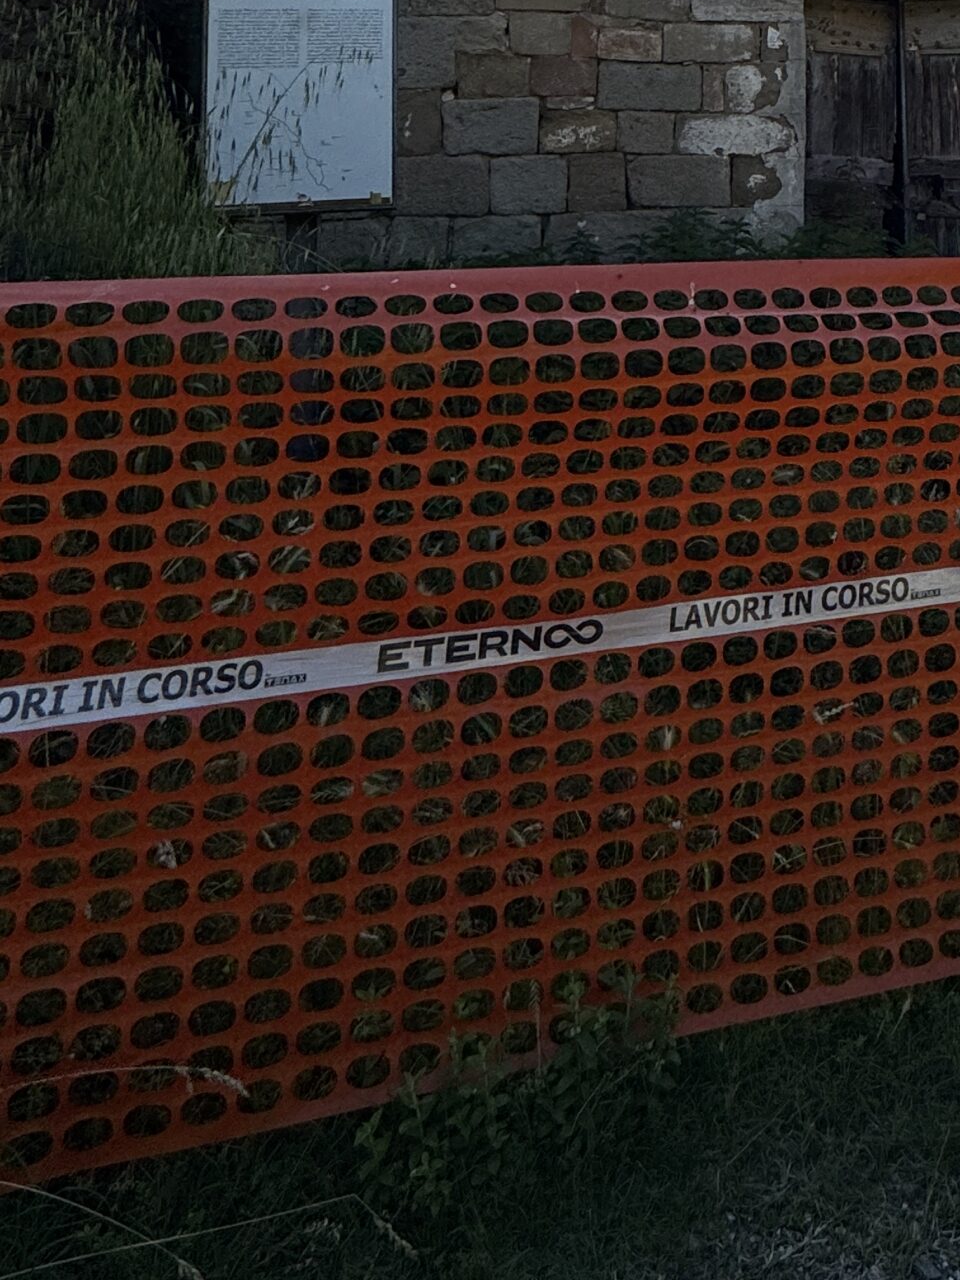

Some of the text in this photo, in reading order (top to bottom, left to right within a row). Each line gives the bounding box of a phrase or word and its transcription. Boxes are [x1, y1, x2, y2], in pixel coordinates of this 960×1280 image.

[669, 577, 910, 632] LAVORI IN CORSO
[77, 677, 126, 713] IN
[136, 659, 264, 704] CORSO
